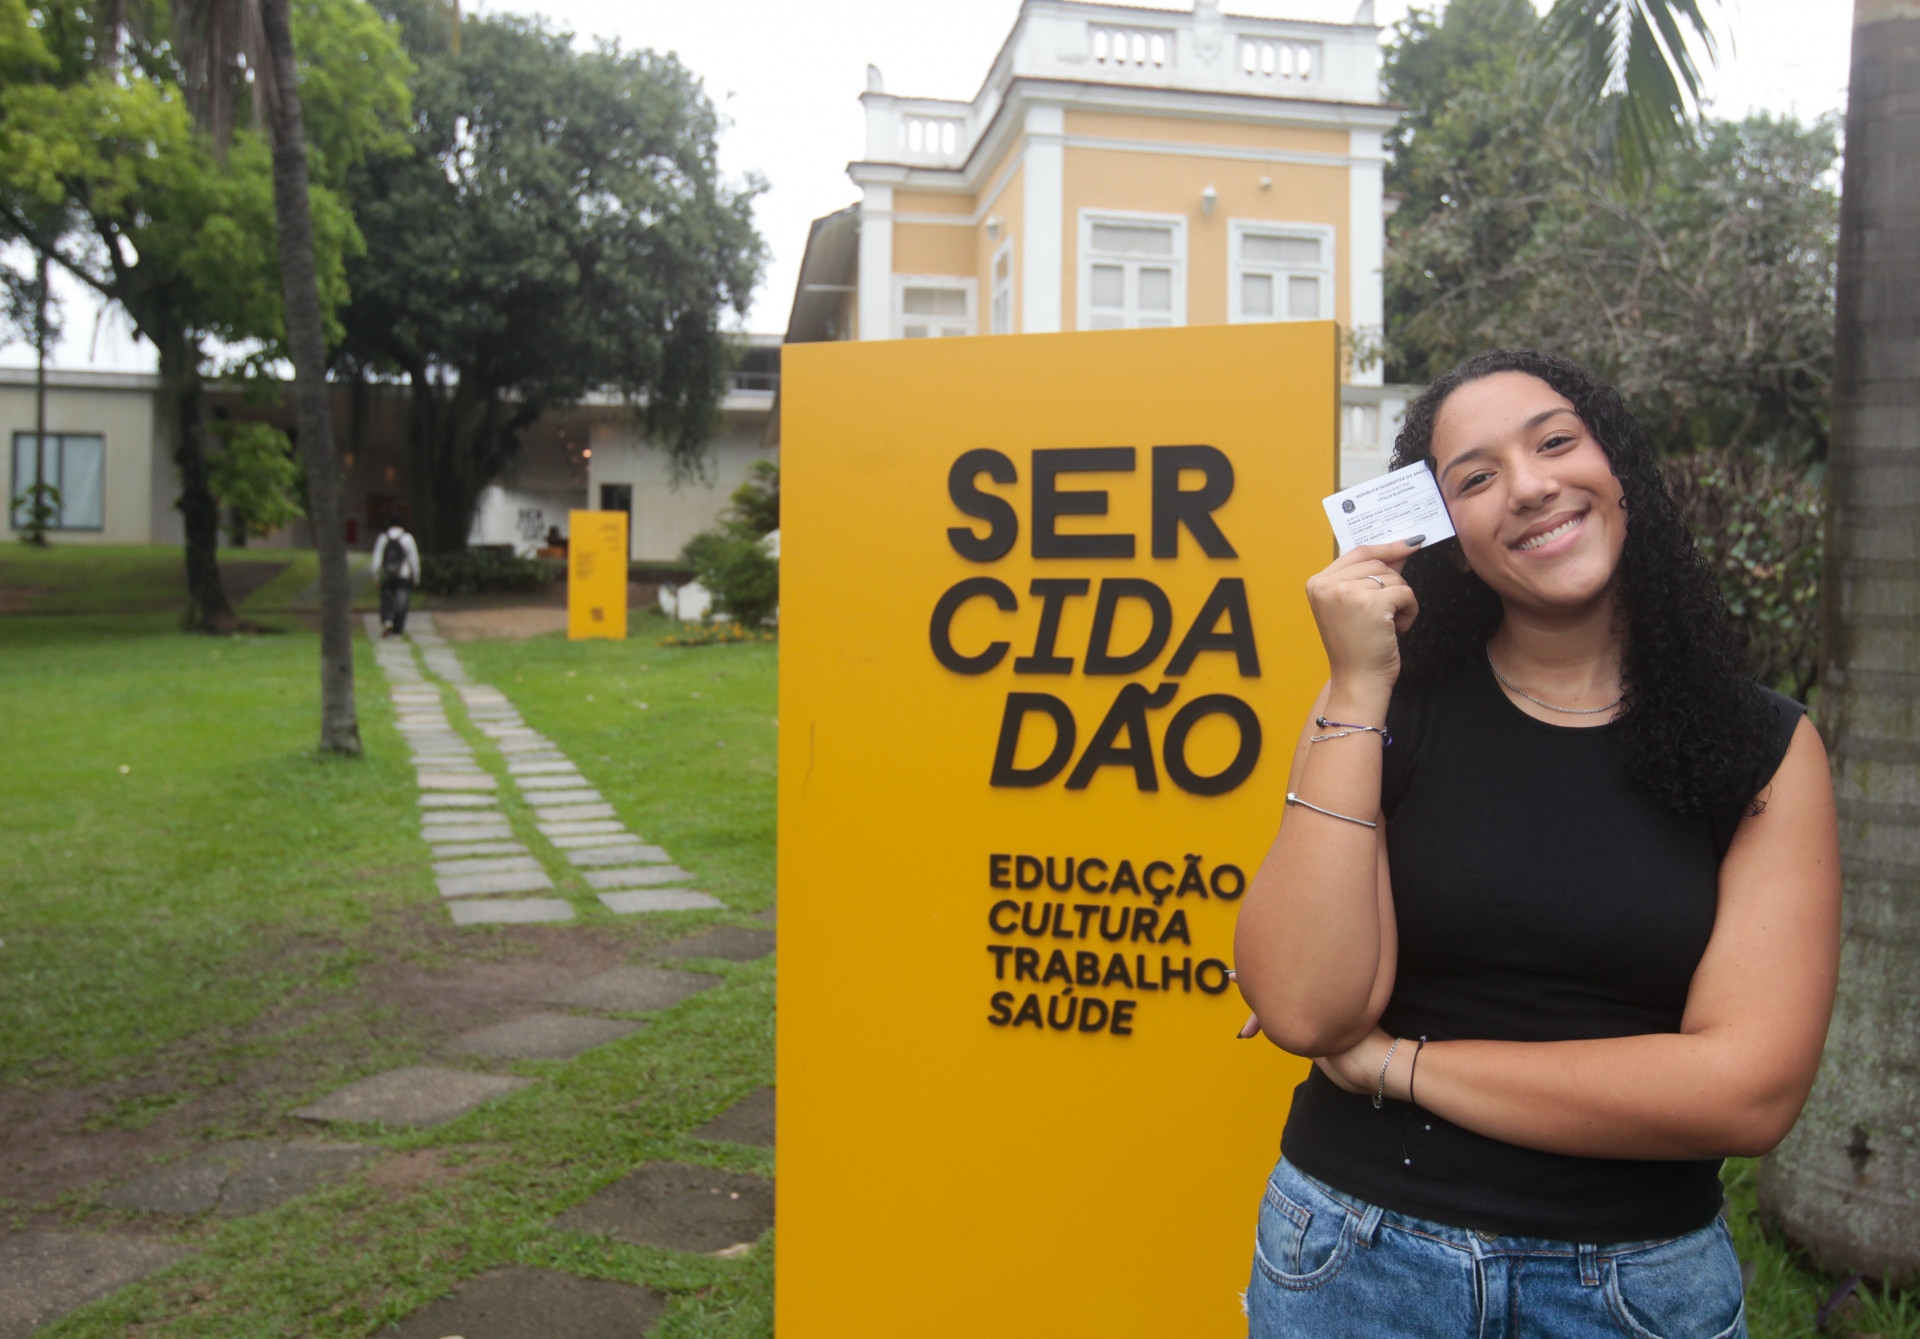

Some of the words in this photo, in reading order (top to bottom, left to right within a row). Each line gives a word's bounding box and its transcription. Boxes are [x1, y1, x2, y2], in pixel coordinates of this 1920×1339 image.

[947, 444, 1239, 563] SER
[929, 576, 1261, 677] CIDA
[990, 682, 1262, 796] DÃO
[989, 853, 1246, 906] EDUCAÇÃO
[988, 899, 1191, 946] CULTURA
[987, 945, 1231, 995] TRABALHO
[987, 987, 1137, 1036] SAÚDE
